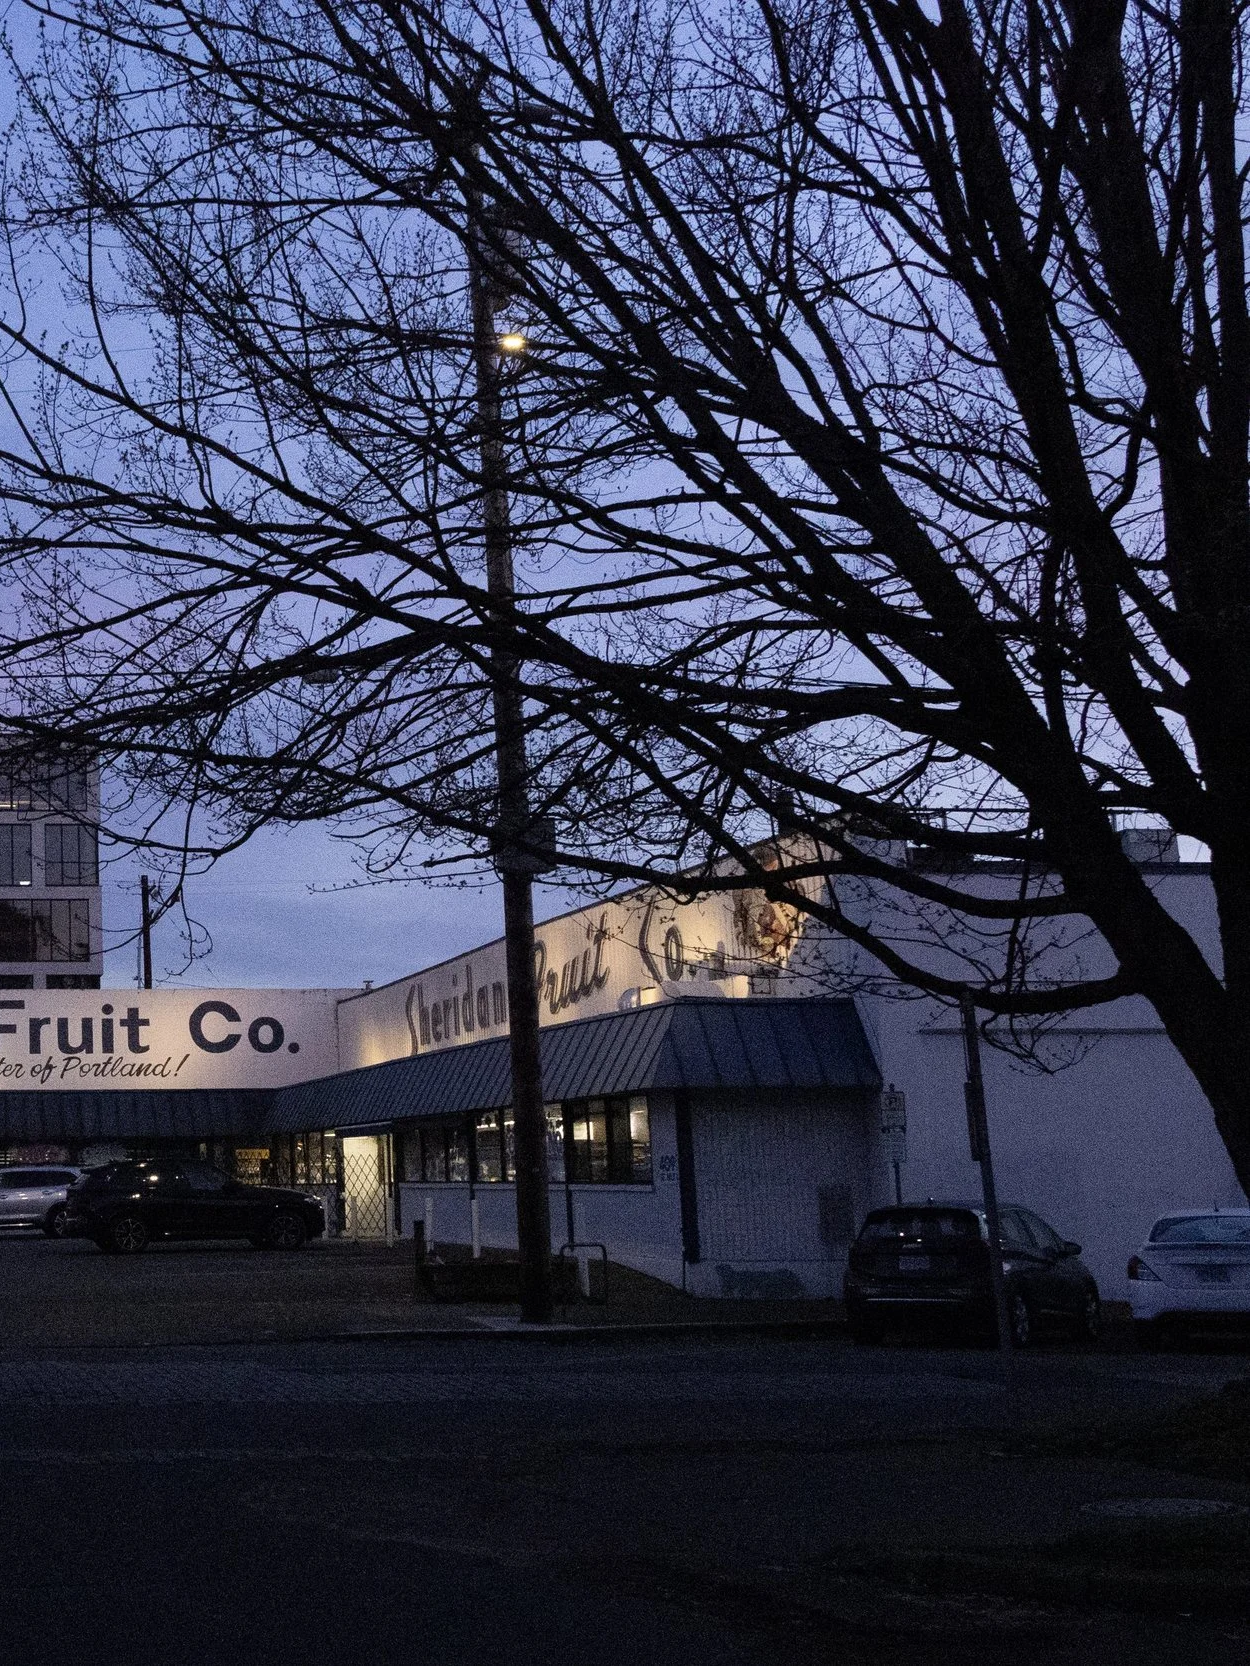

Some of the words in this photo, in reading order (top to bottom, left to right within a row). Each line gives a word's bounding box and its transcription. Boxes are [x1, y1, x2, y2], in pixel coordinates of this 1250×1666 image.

[189, 1000, 301, 1054] Co.
[405, 963, 507, 1057] Sheridan
[30, 1056, 58, 1084] of
[59, 1053, 191, 1080] Portland!
